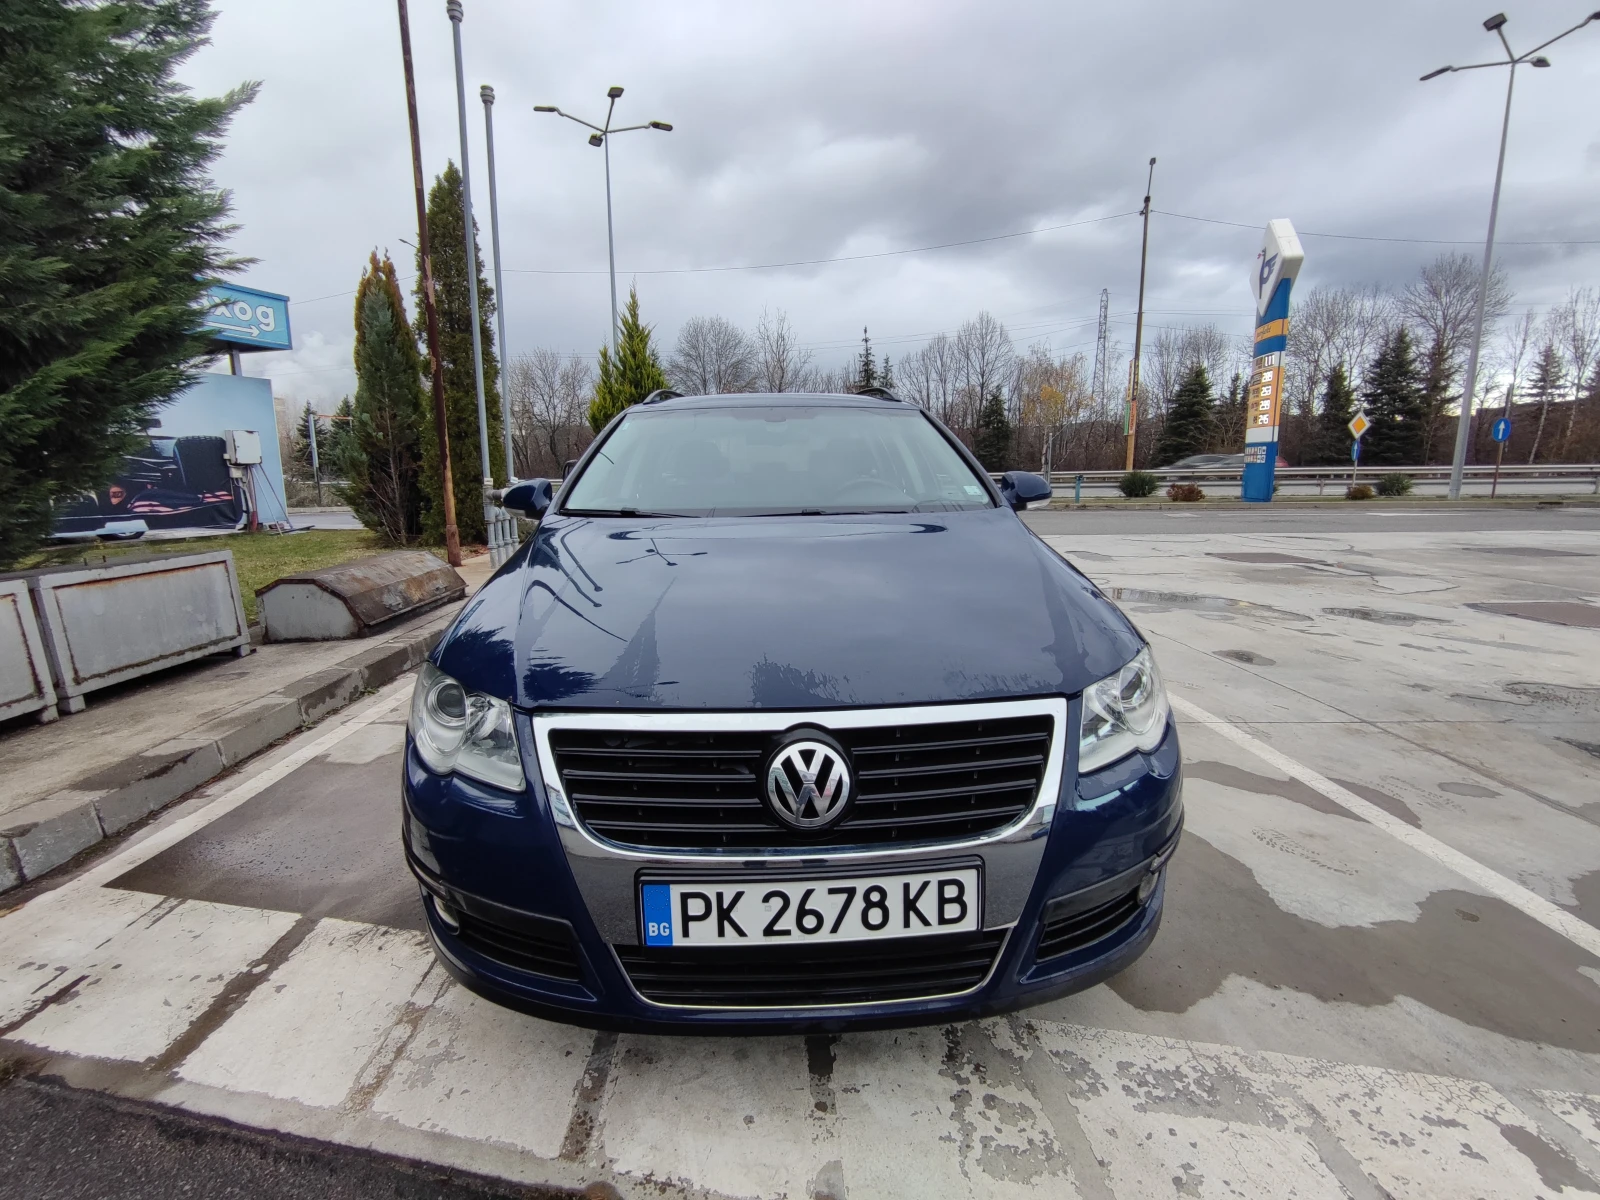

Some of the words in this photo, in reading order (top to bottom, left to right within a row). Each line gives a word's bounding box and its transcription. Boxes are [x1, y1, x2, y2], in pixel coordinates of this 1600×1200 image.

[679, 890, 749, 938] PK
[761, 885, 890, 937] 2678
[902, 878, 968, 929] KB
[648, 922, 670, 937] BG
